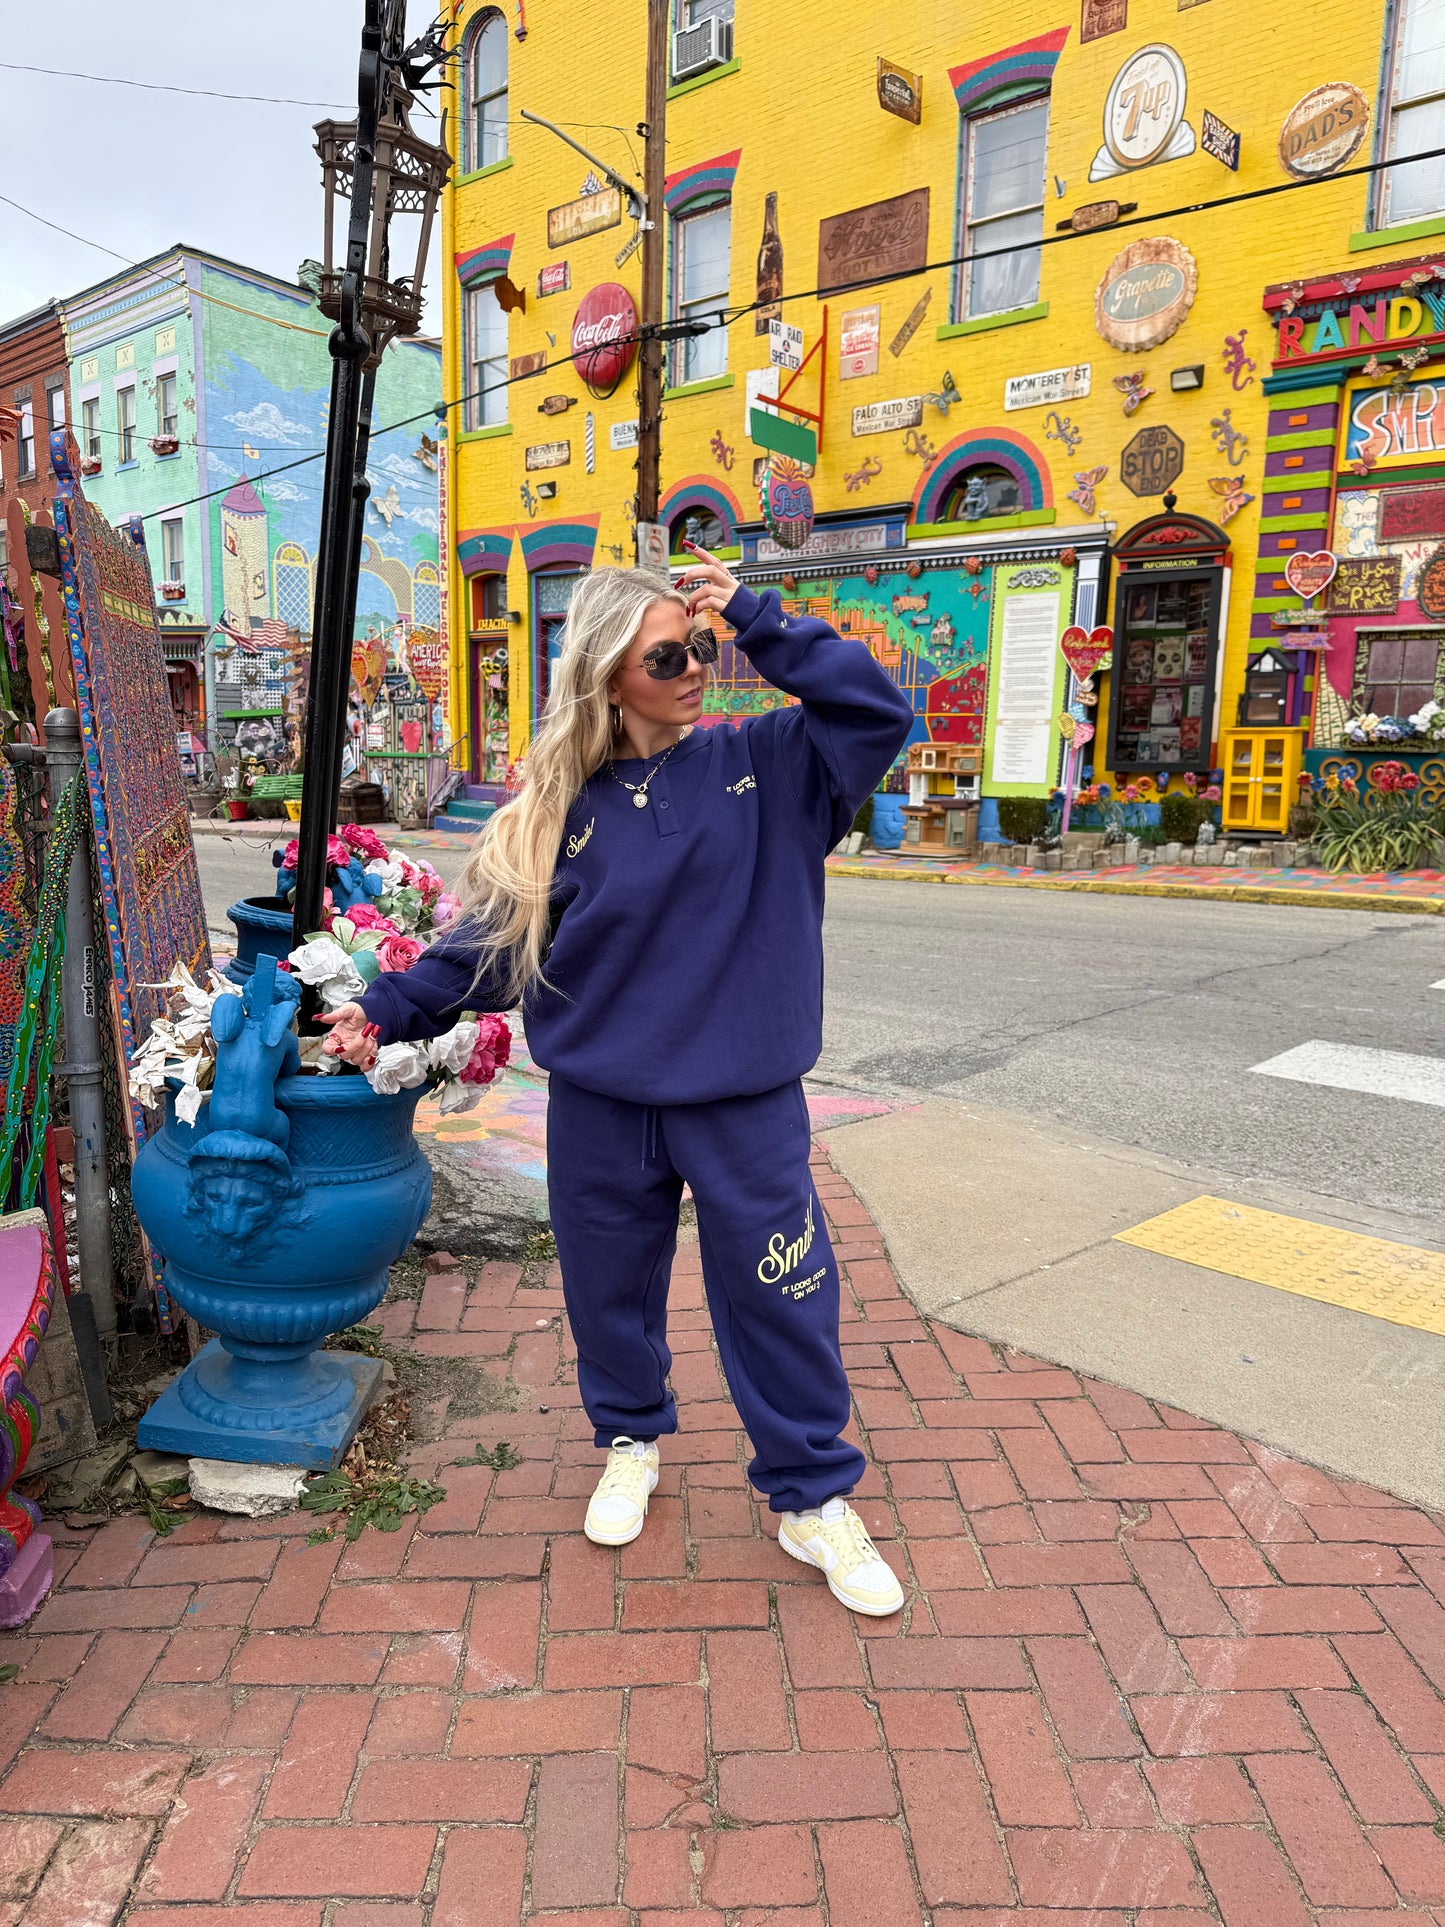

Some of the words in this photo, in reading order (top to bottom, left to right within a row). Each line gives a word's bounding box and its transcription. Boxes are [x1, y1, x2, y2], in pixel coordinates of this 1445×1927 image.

[1288, 99, 1355, 158] DAD'S
[770, 320, 782, 338] AIR
[787, 327, 803, 345] RAID
[771, 349, 801, 370] SHELTER
[1010, 371, 1070, 393] MONTEREY
[855, 403, 878, 421] PALO
[881, 401, 903, 415] ALTO
[1139, 431, 1168, 448] DEAD
[1124, 446, 1179, 478] STOP
[1139, 477, 1161, 492] END
[854, 527, 884, 545] CITY
[1142, 559, 1198, 570] INFORMATION
[440, 590, 449, 662] WELCOME
[85, 947, 94, 983] ENRICO
[83, 984, 94, 1016] JAMES
[781, 1285, 790, 1296] IT
[790, 1277, 812, 1293] LOOKS
[812, 1267, 827, 1282] GOOD
[793, 1292, 805, 1300] ON
[805, 1283, 816, 1295] YOU
